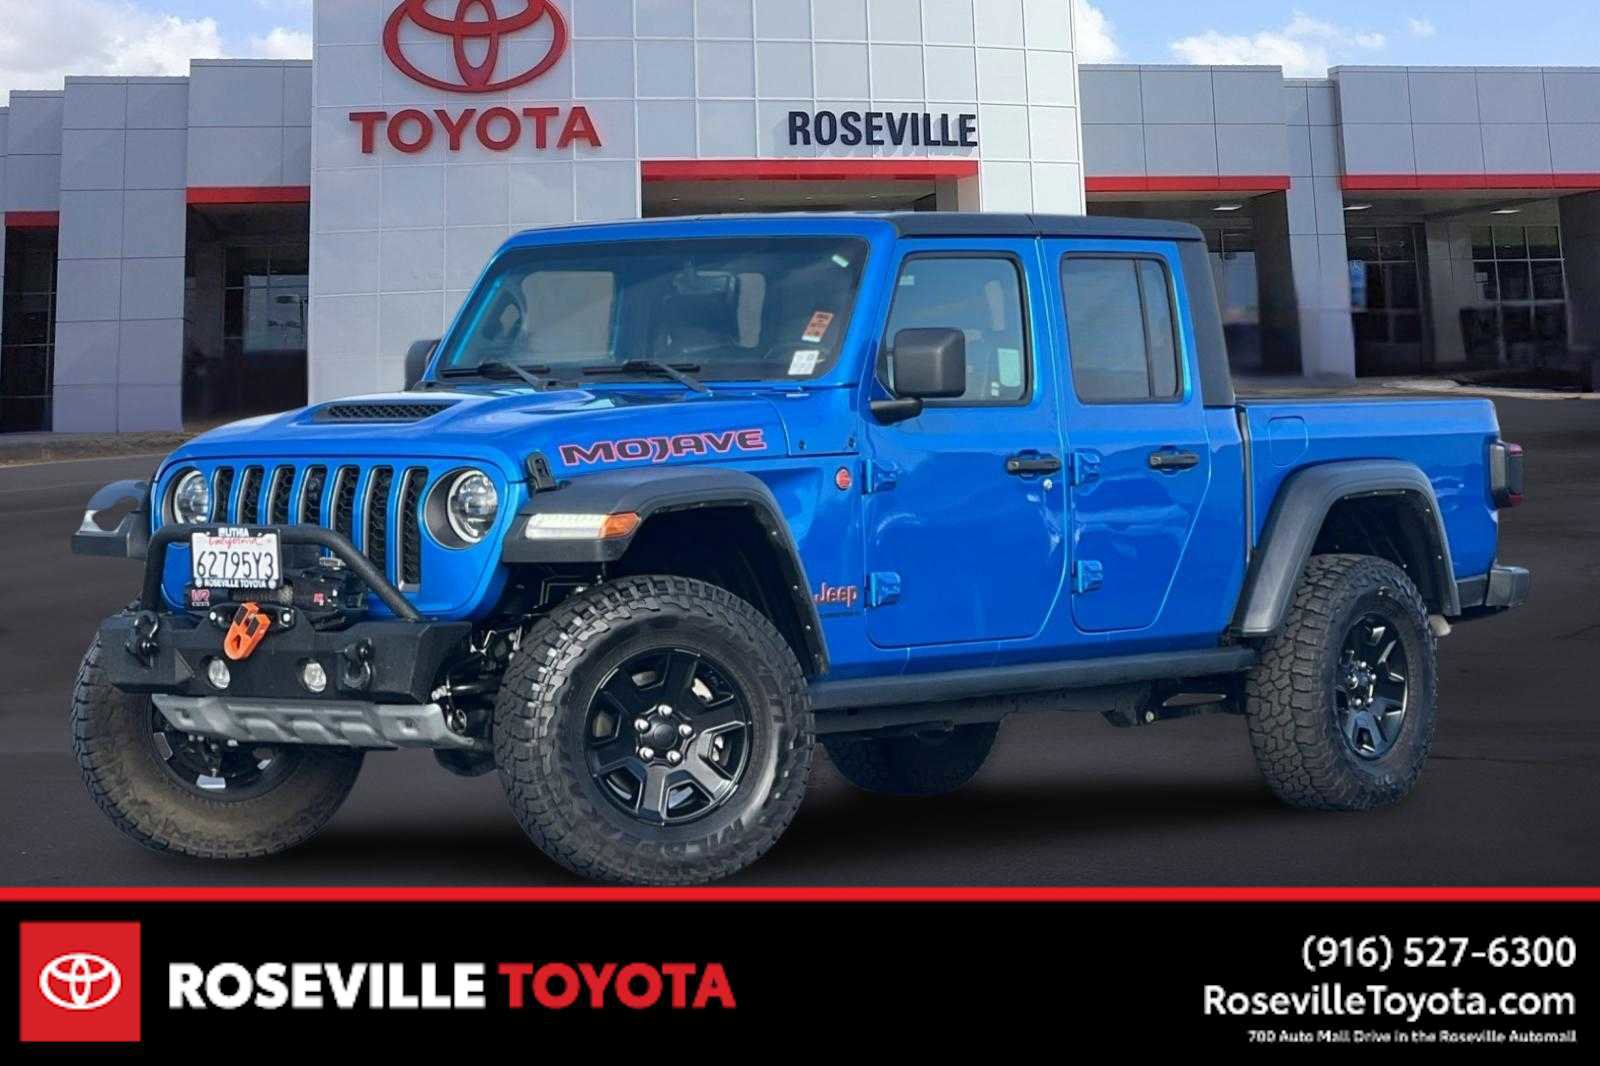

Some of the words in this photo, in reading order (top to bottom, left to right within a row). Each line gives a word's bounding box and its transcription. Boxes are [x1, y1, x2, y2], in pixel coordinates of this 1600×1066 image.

[349, 106, 602, 153] TOYOTA
[788, 111, 979, 147] ROSEVILLE
[559, 429, 767, 466] MOJAVE
[197, 551, 273, 580] 62795Y3
[815, 582, 857, 608] Jeep
